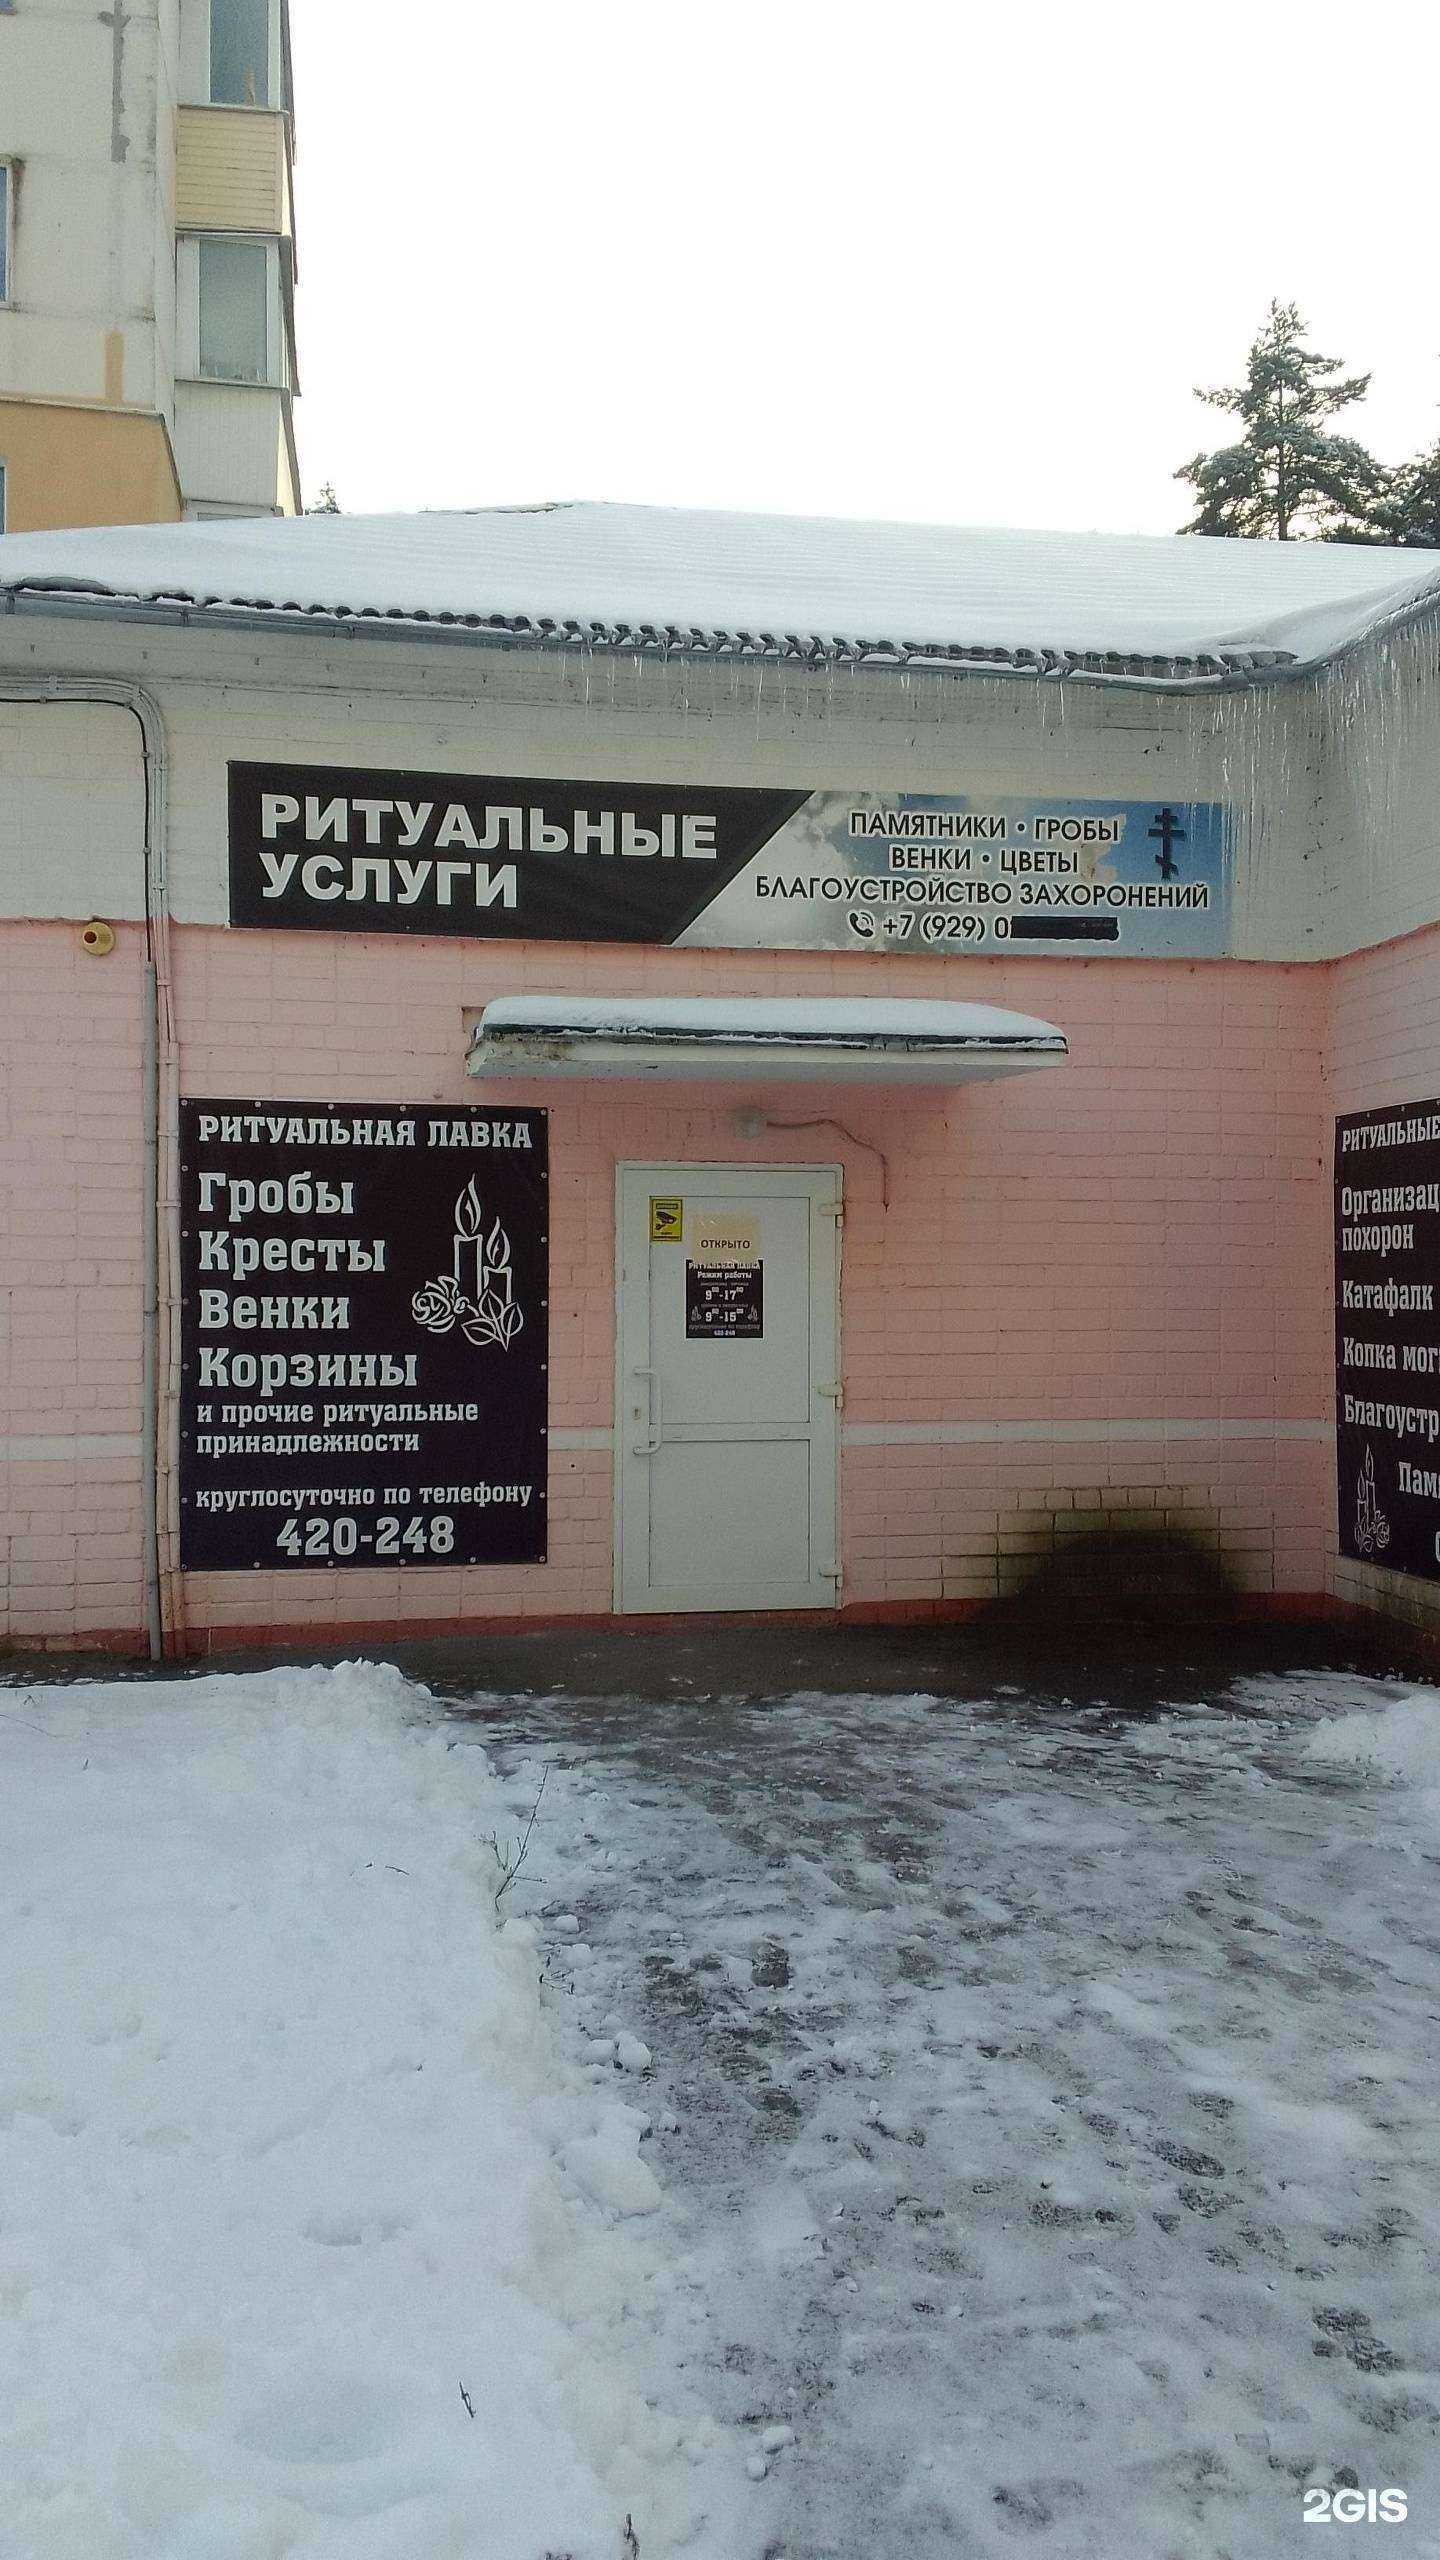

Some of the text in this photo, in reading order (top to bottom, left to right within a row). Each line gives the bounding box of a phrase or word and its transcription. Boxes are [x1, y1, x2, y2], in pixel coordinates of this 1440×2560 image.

[260, 793, 718, 860] РИТУАЛЬНЫЕ
[850, 812, 1119, 843] ПАМЯТНИКИ ГРОБЫ
[258, 852, 518, 908] УСЛУГИ
[891, 847, 1079, 877] ВЕНКИ ЦВЕТЫ
[756, 876, 1209, 909] БЛАГОУСТРОЙСТВО ЗАХОРОНЕНИЙ
[883, 914, 914, 938] +7
[923, 915, 986, 941] (929)
[199, 1115, 533, 1148] РИТУАЛЬНАЯ ЛАВКА
[1342, 1115, 1440, 1152] РИТУАЛЬНЫЕ
[198, 1171, 355, 1223] Гробы
[1341, 1183, 1439, 1222] Организац
[198, 1230, 386, 1281] Кресты
[700, 1239, 751, 1249] ОТКРЫТО
[1342, 1224, 1414, 1257] похорон
[199, 1289, 350, 1329] Венки
[1342, 1277, 1434, 1317] Катафалк
[198, 1347, 417, 1397] Корзины
[1343, 1337, 1440, 1374] Копка мог
[197, 1403, 479, 1428] и прочие ритуальные
[1344, 1394, 1440, 1443] Благоустр
[196, 1433, 420, 1459] принадлежности
[195, 1481, 533, 1512] круглосуточно по телефону
[1398, 1461, 1440, 1500] Пам
[276, 1515, 455, 1557] 420-248
